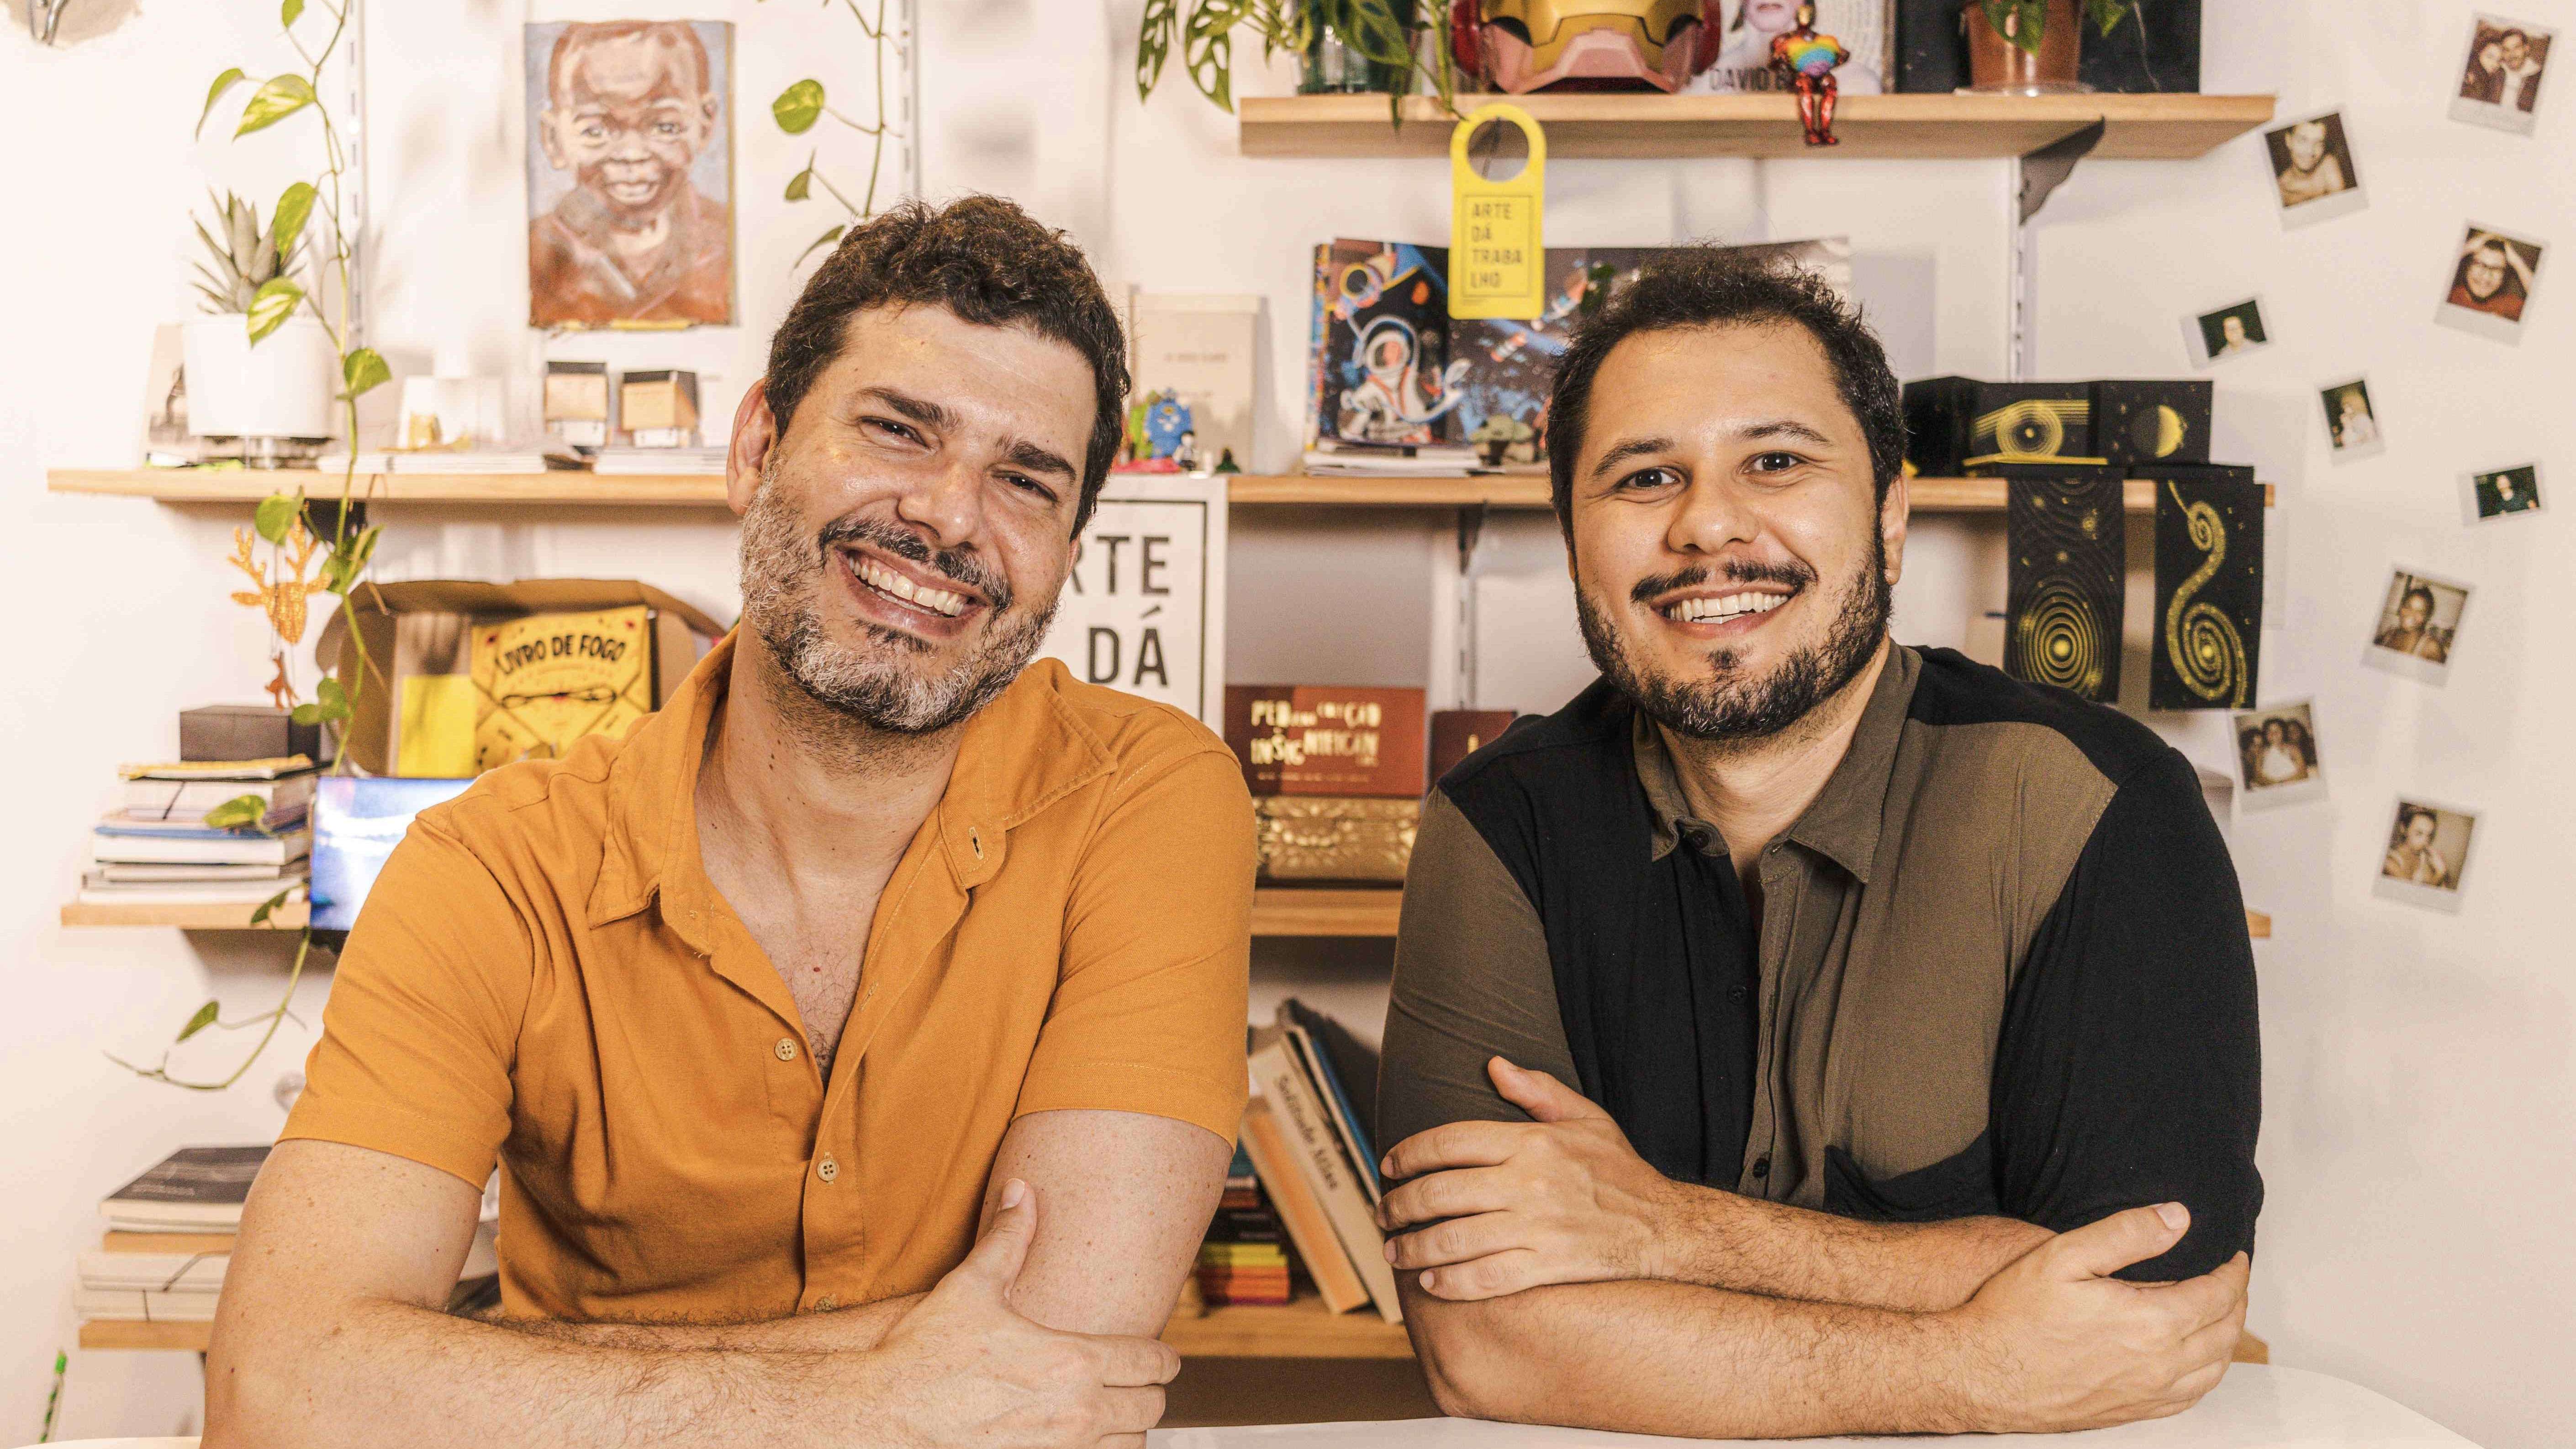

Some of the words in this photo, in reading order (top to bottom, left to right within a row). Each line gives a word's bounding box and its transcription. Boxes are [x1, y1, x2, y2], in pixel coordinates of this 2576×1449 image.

[1709, 68, 1768, 90] DAVID
[1472, 203, 1512, 220] ARTE
[1471, 223, 1492, 242] DÁ
[1472, 249, 1522, 264] TRABA
[1470, 272, 1501, 288] LHO
[495, 640, 546, 674] LIVRO
[552, 634, 574, 657] DE
[579, 634, 626, 662] FOGO
[1088, 605, 1168, 685] DÁ
